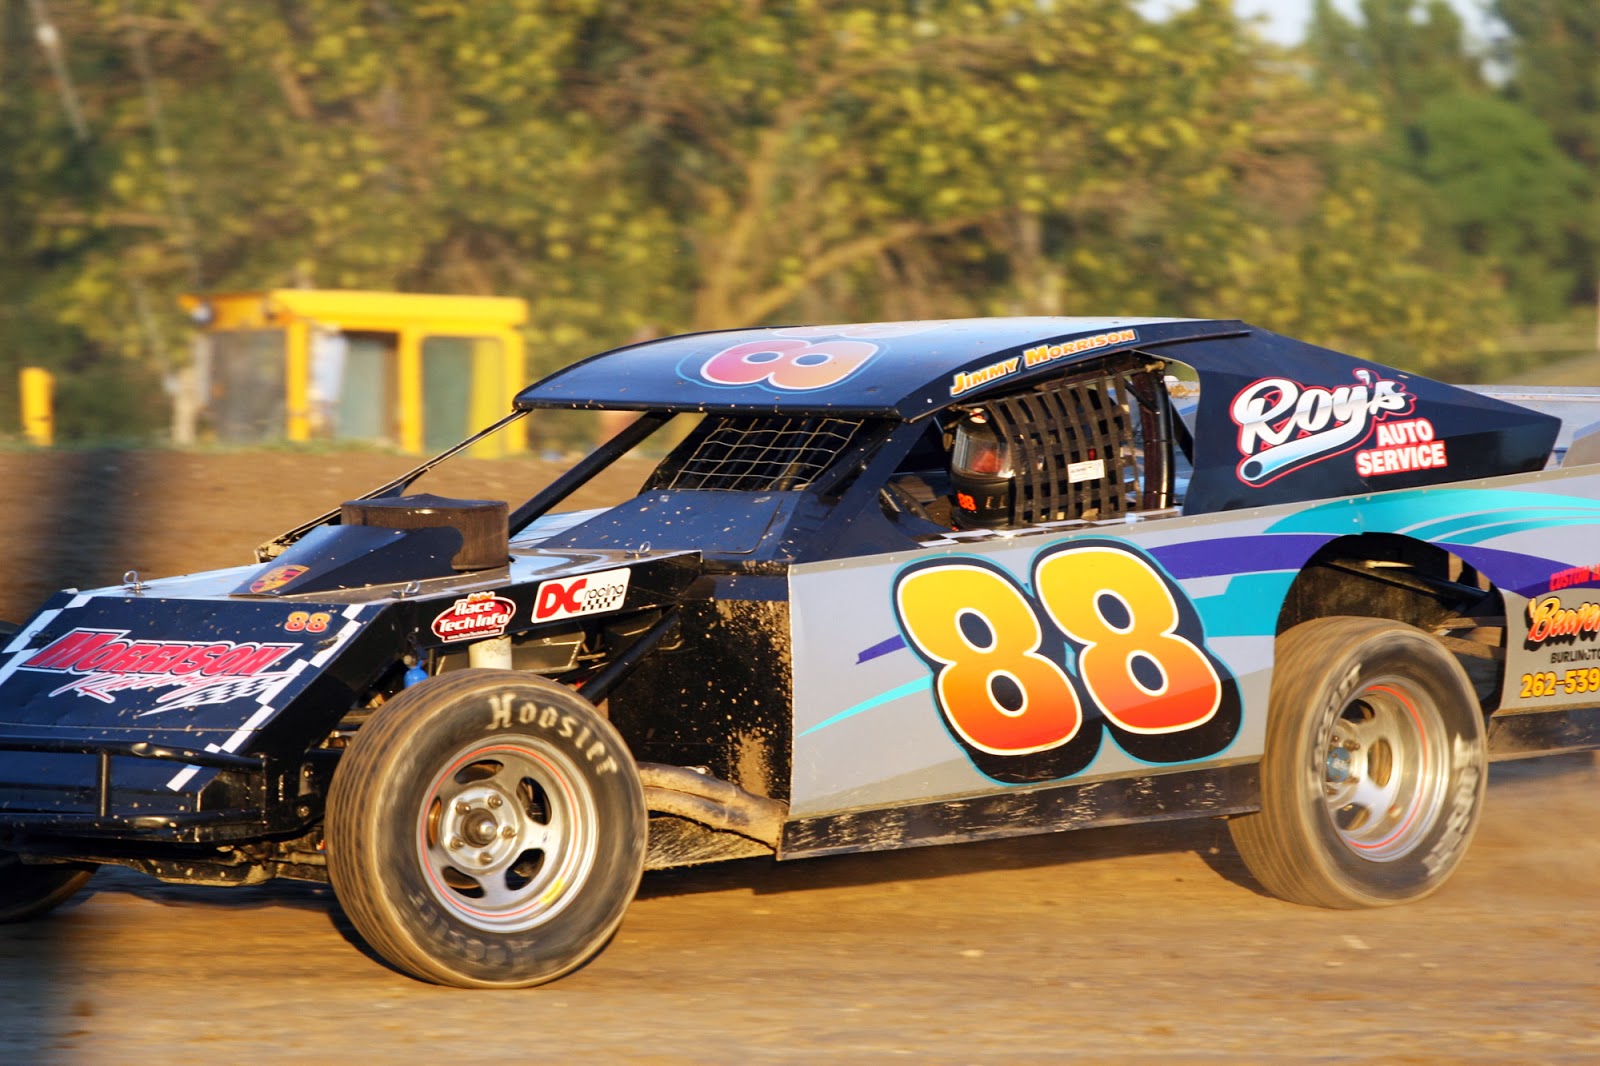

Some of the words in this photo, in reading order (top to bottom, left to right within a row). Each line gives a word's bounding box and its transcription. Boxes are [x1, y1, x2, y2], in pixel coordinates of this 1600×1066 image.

[951, 356, 1020, 396] JIMMY
[1023, 329, 1137, 367] MORRISON
[1233, 369, 1406, 481] Roy's
[1377, 418, 1435, 446] AUTO
[1356, 441, 1447, 477] SERVICE
[455, 600, 495, 616] Race
[536, 578, 587, 619] DC
[583, 583, 625, 600] racing
[284, 611, 332, 633] 88
[20, 628, 299, 677] MORRISON
[894, 543, 1230, 764] 88
